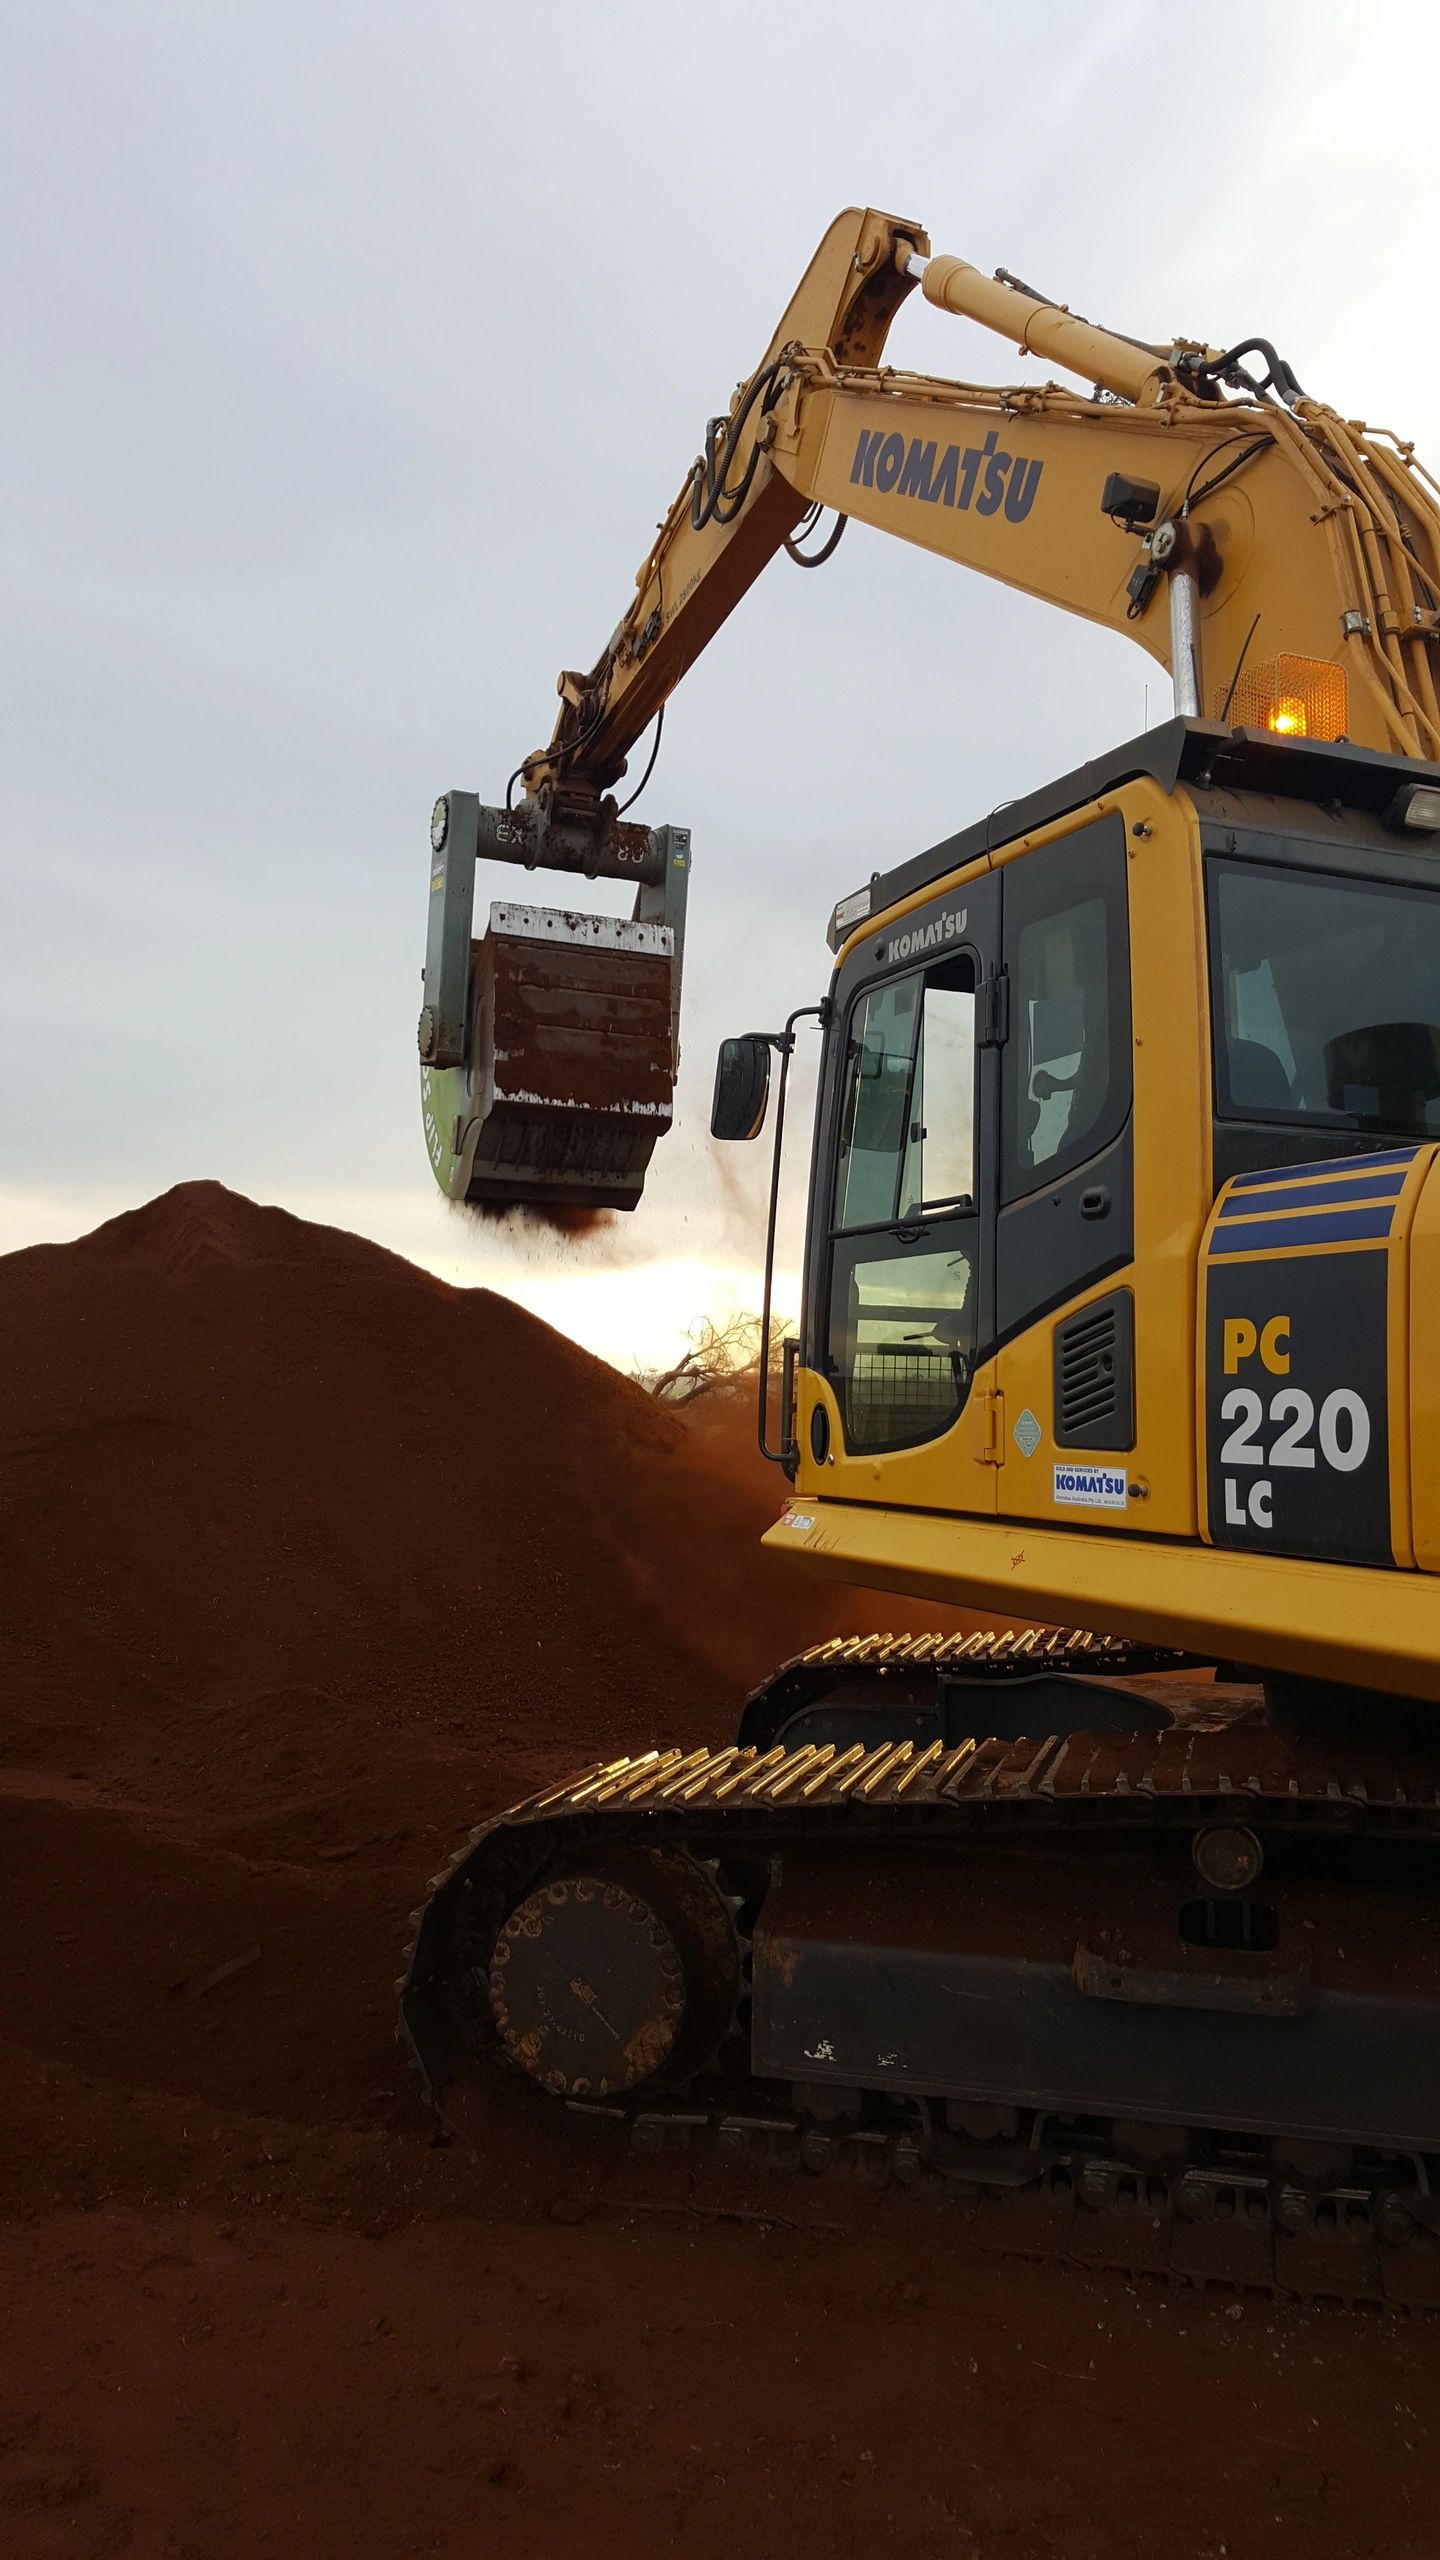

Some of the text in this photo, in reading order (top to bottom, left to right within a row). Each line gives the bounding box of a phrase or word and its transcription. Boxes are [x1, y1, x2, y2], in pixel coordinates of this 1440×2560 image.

[850, 429, 1044, 523] KOMATSU
[888, 909, 967, 963] KOMATSU
[1223, 1315, 1290, 1375] PC
[1220, 1388, 1371, 1472] 220
[1056, 1473, 1124, 1495] KOMATSU
[1224, 1478, 1273, 1529] LC
